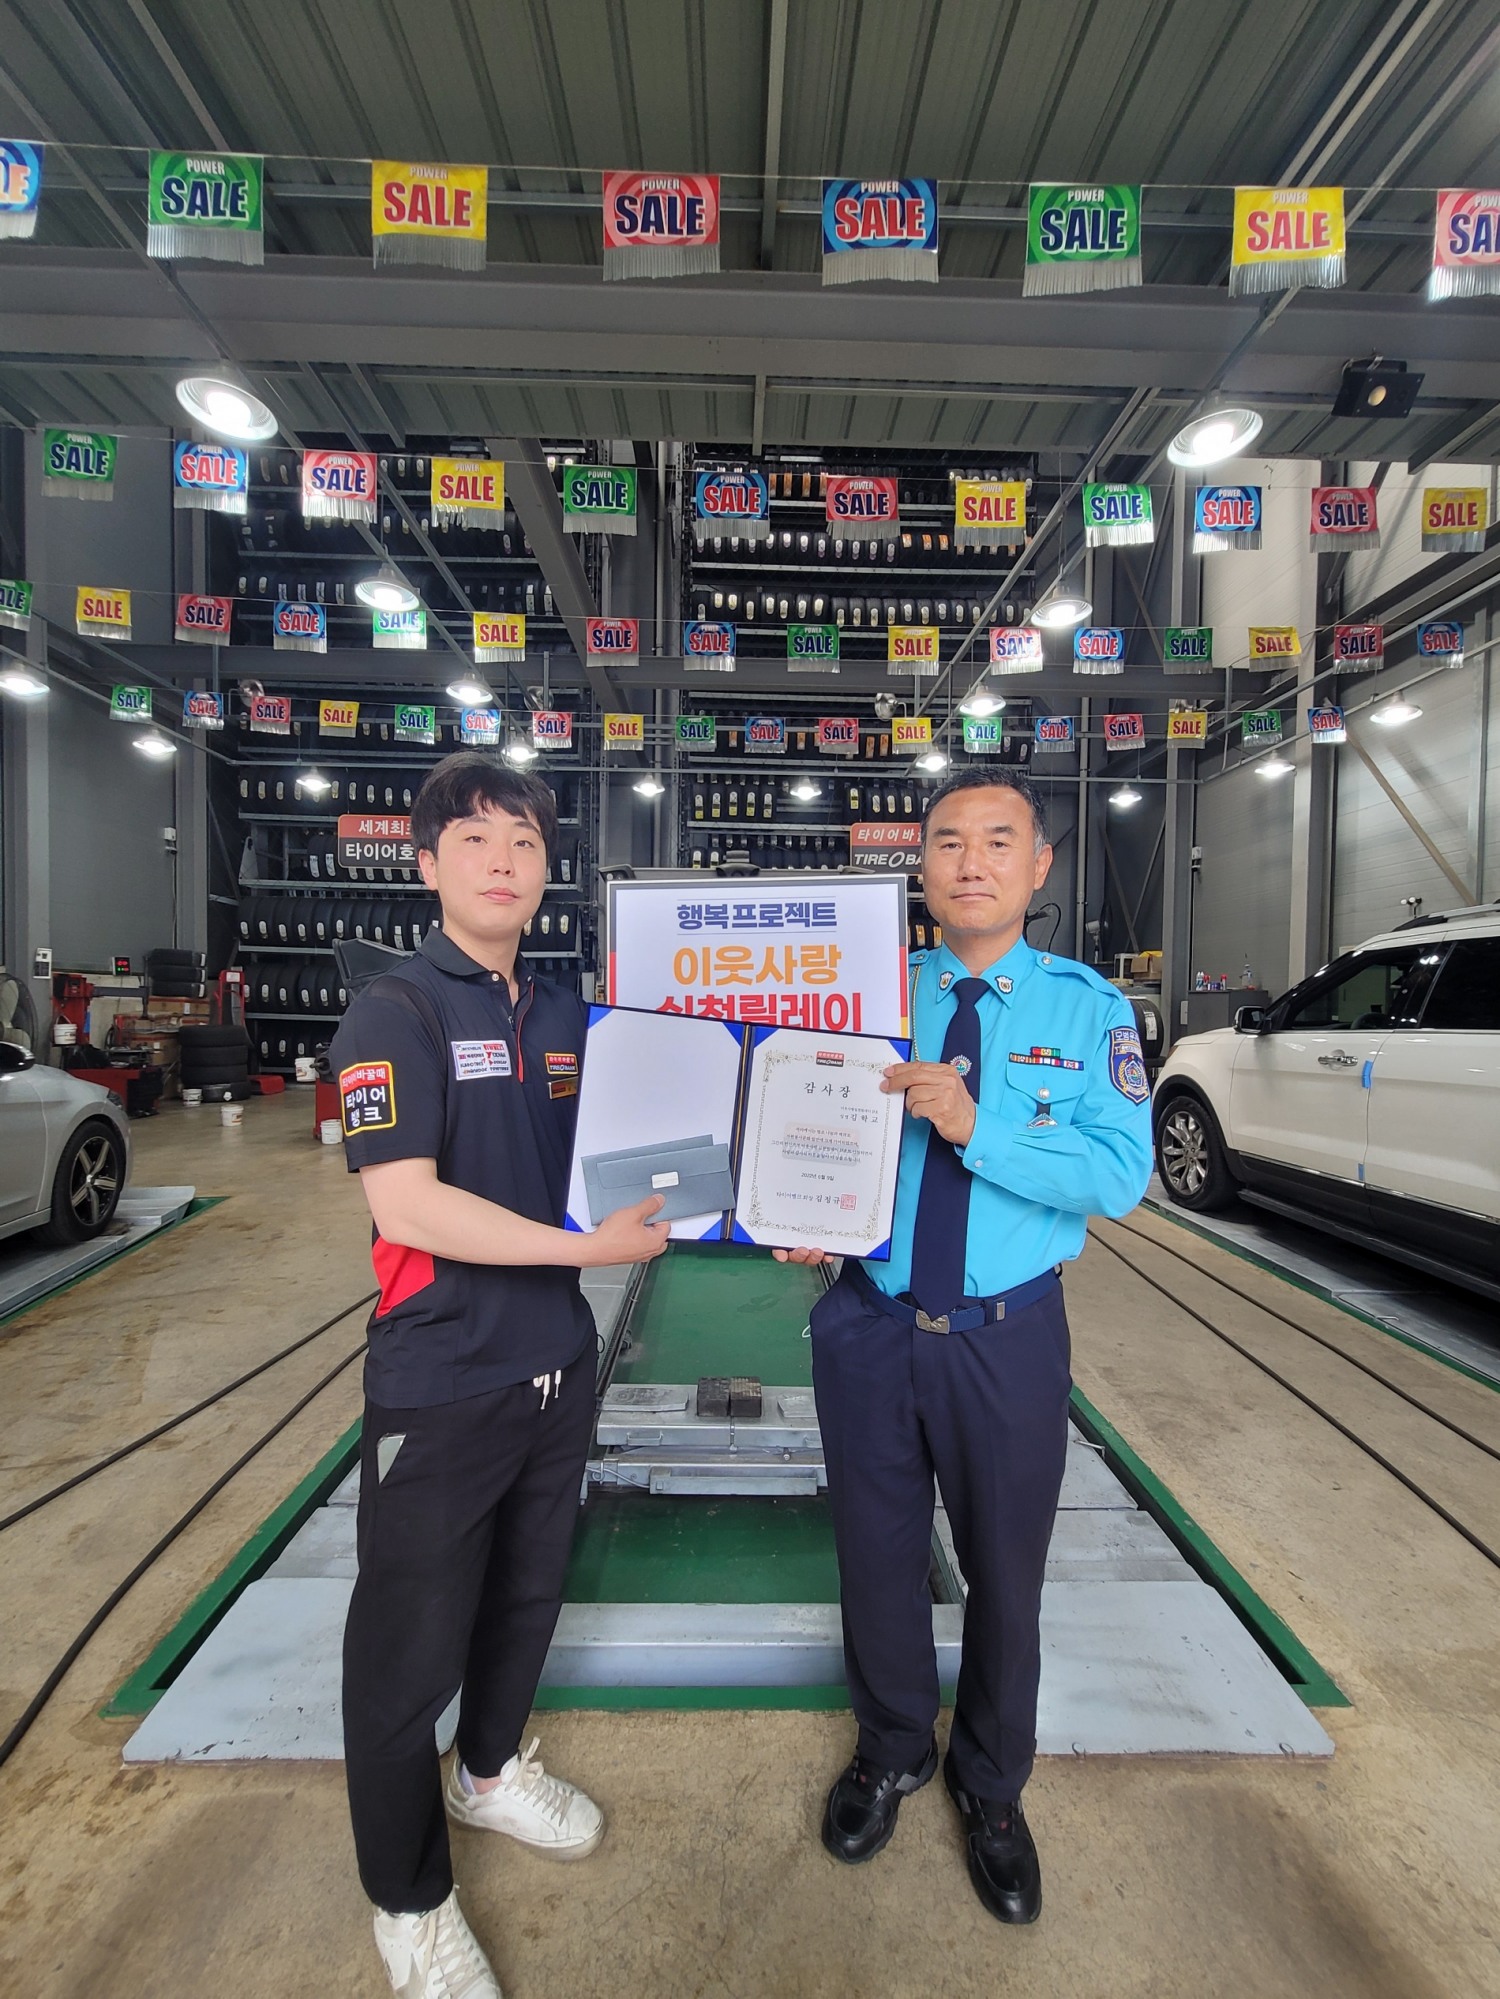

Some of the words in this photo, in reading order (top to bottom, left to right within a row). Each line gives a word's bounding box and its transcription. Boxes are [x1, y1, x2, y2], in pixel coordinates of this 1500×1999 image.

[186, 157, 226, 176] POWER
[410, 166, 450, 181] POWER
[641, 177, 682, 193] POWER
[860, 180, 900, 195] POWER
[161, 176, 249, 220] SALE
[1067, 189, 1106, 204] POWER
[1272, 191, 1310, 206] POWER
[383, 183, 474, 229] SALE
[613, 195, 706, 239] SALE
[834, 199, 928, 241] SALE
[1039, 208, 1129, 254] SALE
[1246, 211, 1331, 252] SALE
[1449, 213, 1500, 255] SA
[67, 433, 93, 445] POWER
[197, 444, 223, 455] POWER
[50, 444, 110, 477] SALE
[328, 456, 354, 466] POWER
[455, 462, 480, 473] POWER
[180, 456, 239, 486] SALE
[587, 470, 612, 479] POWER
[720, 475, 745, 485] POWER
[311, 466, 368, 495] SALE
[439, 474, 495, 502] SALE
[849, 480, 874, 490] POWER
[979, 484, 1004, 493] POWER
[1104, 484, 1128, 493] POWER
[570, 480, 628, 510] SALE
[703, 484, 761, 514] SALE
[1218, 489, 1241, 498] POWER
[834, 491, 890, 517] SALE
[963, 496, 1017, 523] SALE
[1090, 495, 1143, 521] SALE
[1202, 500, 1255, 527] SALE
[1319, 502, 1369, 528] SALE
[1428, 503, 1479, 527] SALE
[83, 598, 123, 620] SALE
[184, 603, 225, 626] SALE
[279, 612, 320, 633] SALE
[479, 624, 519, 643] SALE
[592, 628, 632, 649] SALE
[689, 632, 730, 652] SALE
[1423, 632, 1459, 650] SALE
[793, 636, 833, 654] SALE
[894, 638, 933, 656] SALE
[1079, 637, 1118, 656] SALE
[1170, 637, 1206, 656] SALE
[1255, 636, 1293, 653] SALE
[1340, 634, 1376, 655] SALE
[117, 693, 146, 709] SALE
[188, 700, 219, 716] SALE
[256, 703, 286, 720] SALE
[323, 708, 353, 723] SALE
[399, 713, 429, 729] SALE
[537, 718, 566, 734] SALE
[608, 722, 638, 736] SALE
[1109, 722, 1139, 737] SALE
[1172, 720, 1201, 735] SALE
[1248, 717, 1276, 732] SALE
[1311, 714, 1342, 730] SALE
[680, 723, 710, 739] SALE
[750, 725, 780, 740] SALE
[824, 726, 854, 740] SALE
[896, 726, 926, 739] SALE
[967, 724, 997, 739] SALE
[1039, 724, 1070, 739] SALE
[857, 828, 921, 842] 타이어바
[673, 944, 842, 987] 이웃사랑
[345, 1085, 386, 1108] 타이어
[351, 1106, 382, 1127] 뱅크
